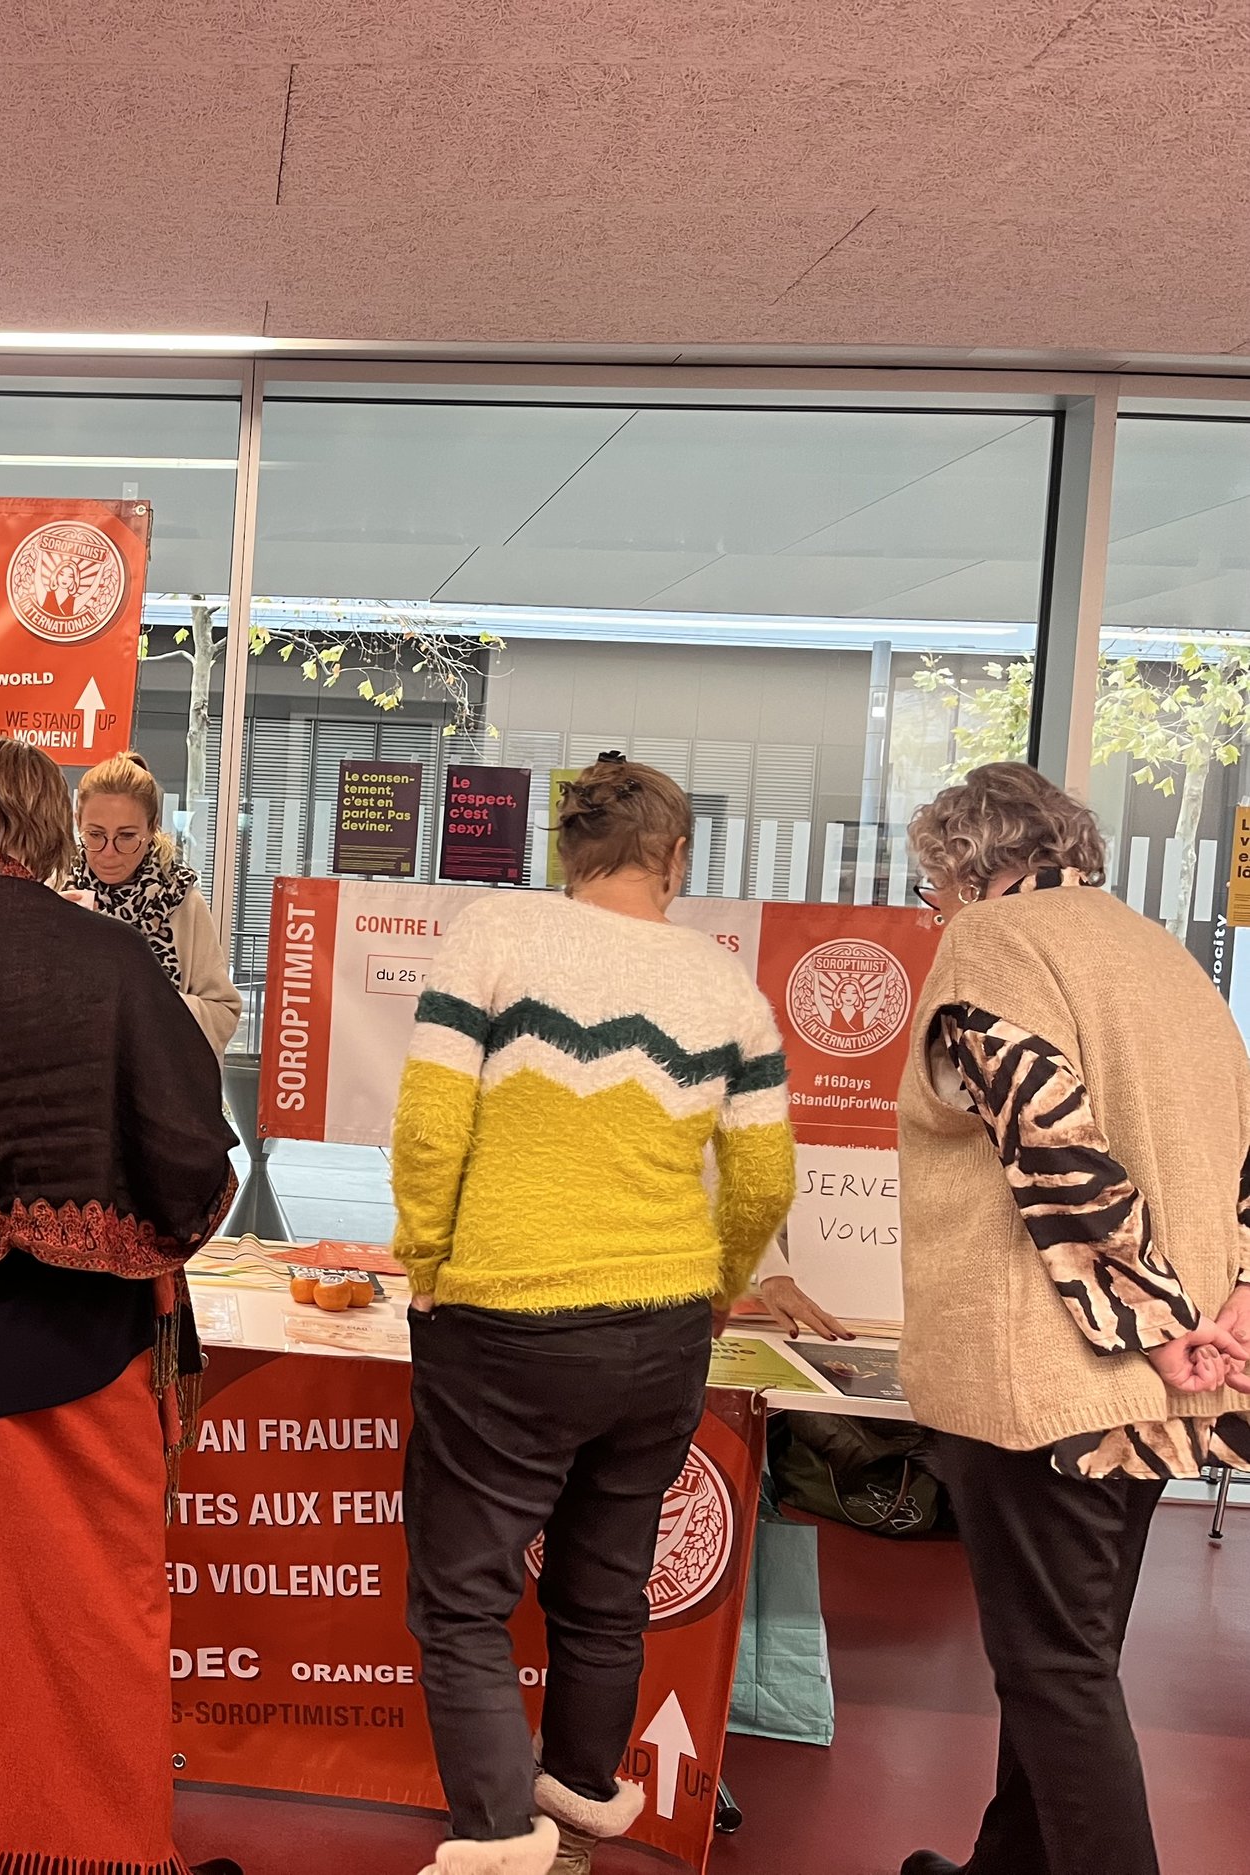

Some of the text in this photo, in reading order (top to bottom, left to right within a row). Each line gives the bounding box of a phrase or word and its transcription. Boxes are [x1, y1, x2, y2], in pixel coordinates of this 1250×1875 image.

[41, 536, 107, 560] SOROPTIMIST
[20, 600, 95, 633] INTERNATIONAL
[6, 711, 117, 731] WE STAND UP
[13, 729, 78, 748] WOMEN!
[344, 771, 415, 784] Le consen-
[452, 776, 470, 788] Le
[344, 784, 395, 797] tement,
[377, 799, 393, 807] en
[450, 793, 517, 808] respect,
[342, 809, 411, 820] parler. Pas
[341, 820, 394, 832] deviner.
[448, 823, 485, 837] sexy
[355, 915, 428, 937] CONTRE
[1212, 914, 1228, 988] rocity
[815, 957, 886, 973] SOROPTIMIST
[376, 968, 395, 982] du
[398, 969, 417, 982] 25
[276, 902, 316, 1111] SOROPTIMIST
[806, 1018, 889, 1050] INTERNATIONAL
[813, 1074, 872, 1091] #16Days
[197, 1418, 400, 1452] AN FRAUEN
[177, 1491, 405, 1526] TES AUX FEM
[207, 1563, 382, 1597] VIOLENCE
[169, 1646, 415, 1684] DEC ORANGE
[171, 1700, 405, 1729] S-SOROPTIMIST.CH
